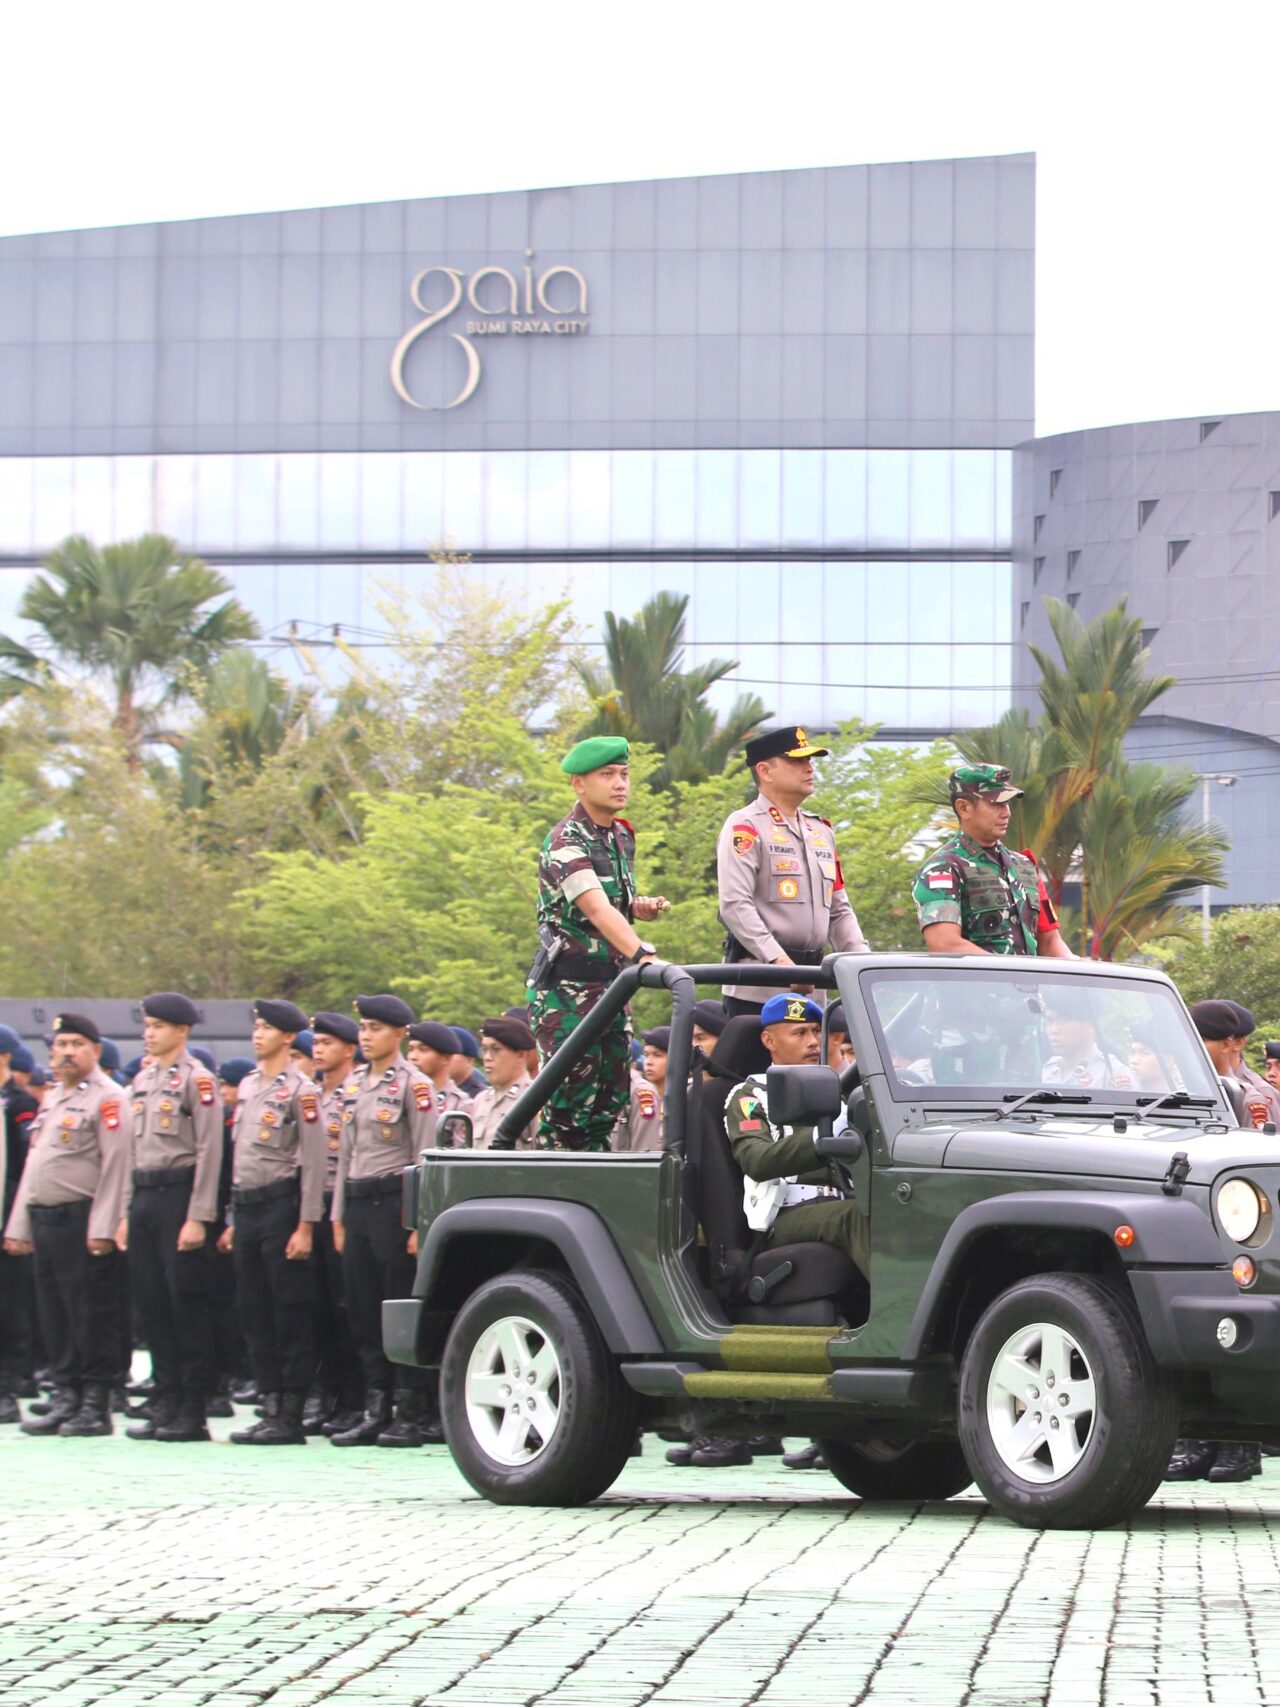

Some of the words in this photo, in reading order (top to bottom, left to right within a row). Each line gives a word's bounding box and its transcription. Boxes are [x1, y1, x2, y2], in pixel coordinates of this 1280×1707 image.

[390, 248, 589, 410] gaia
[466, 321, 506, 334] BUMI
[512, 321, 551, 333] RAYA
[554, 321, 588, 333] CITY
